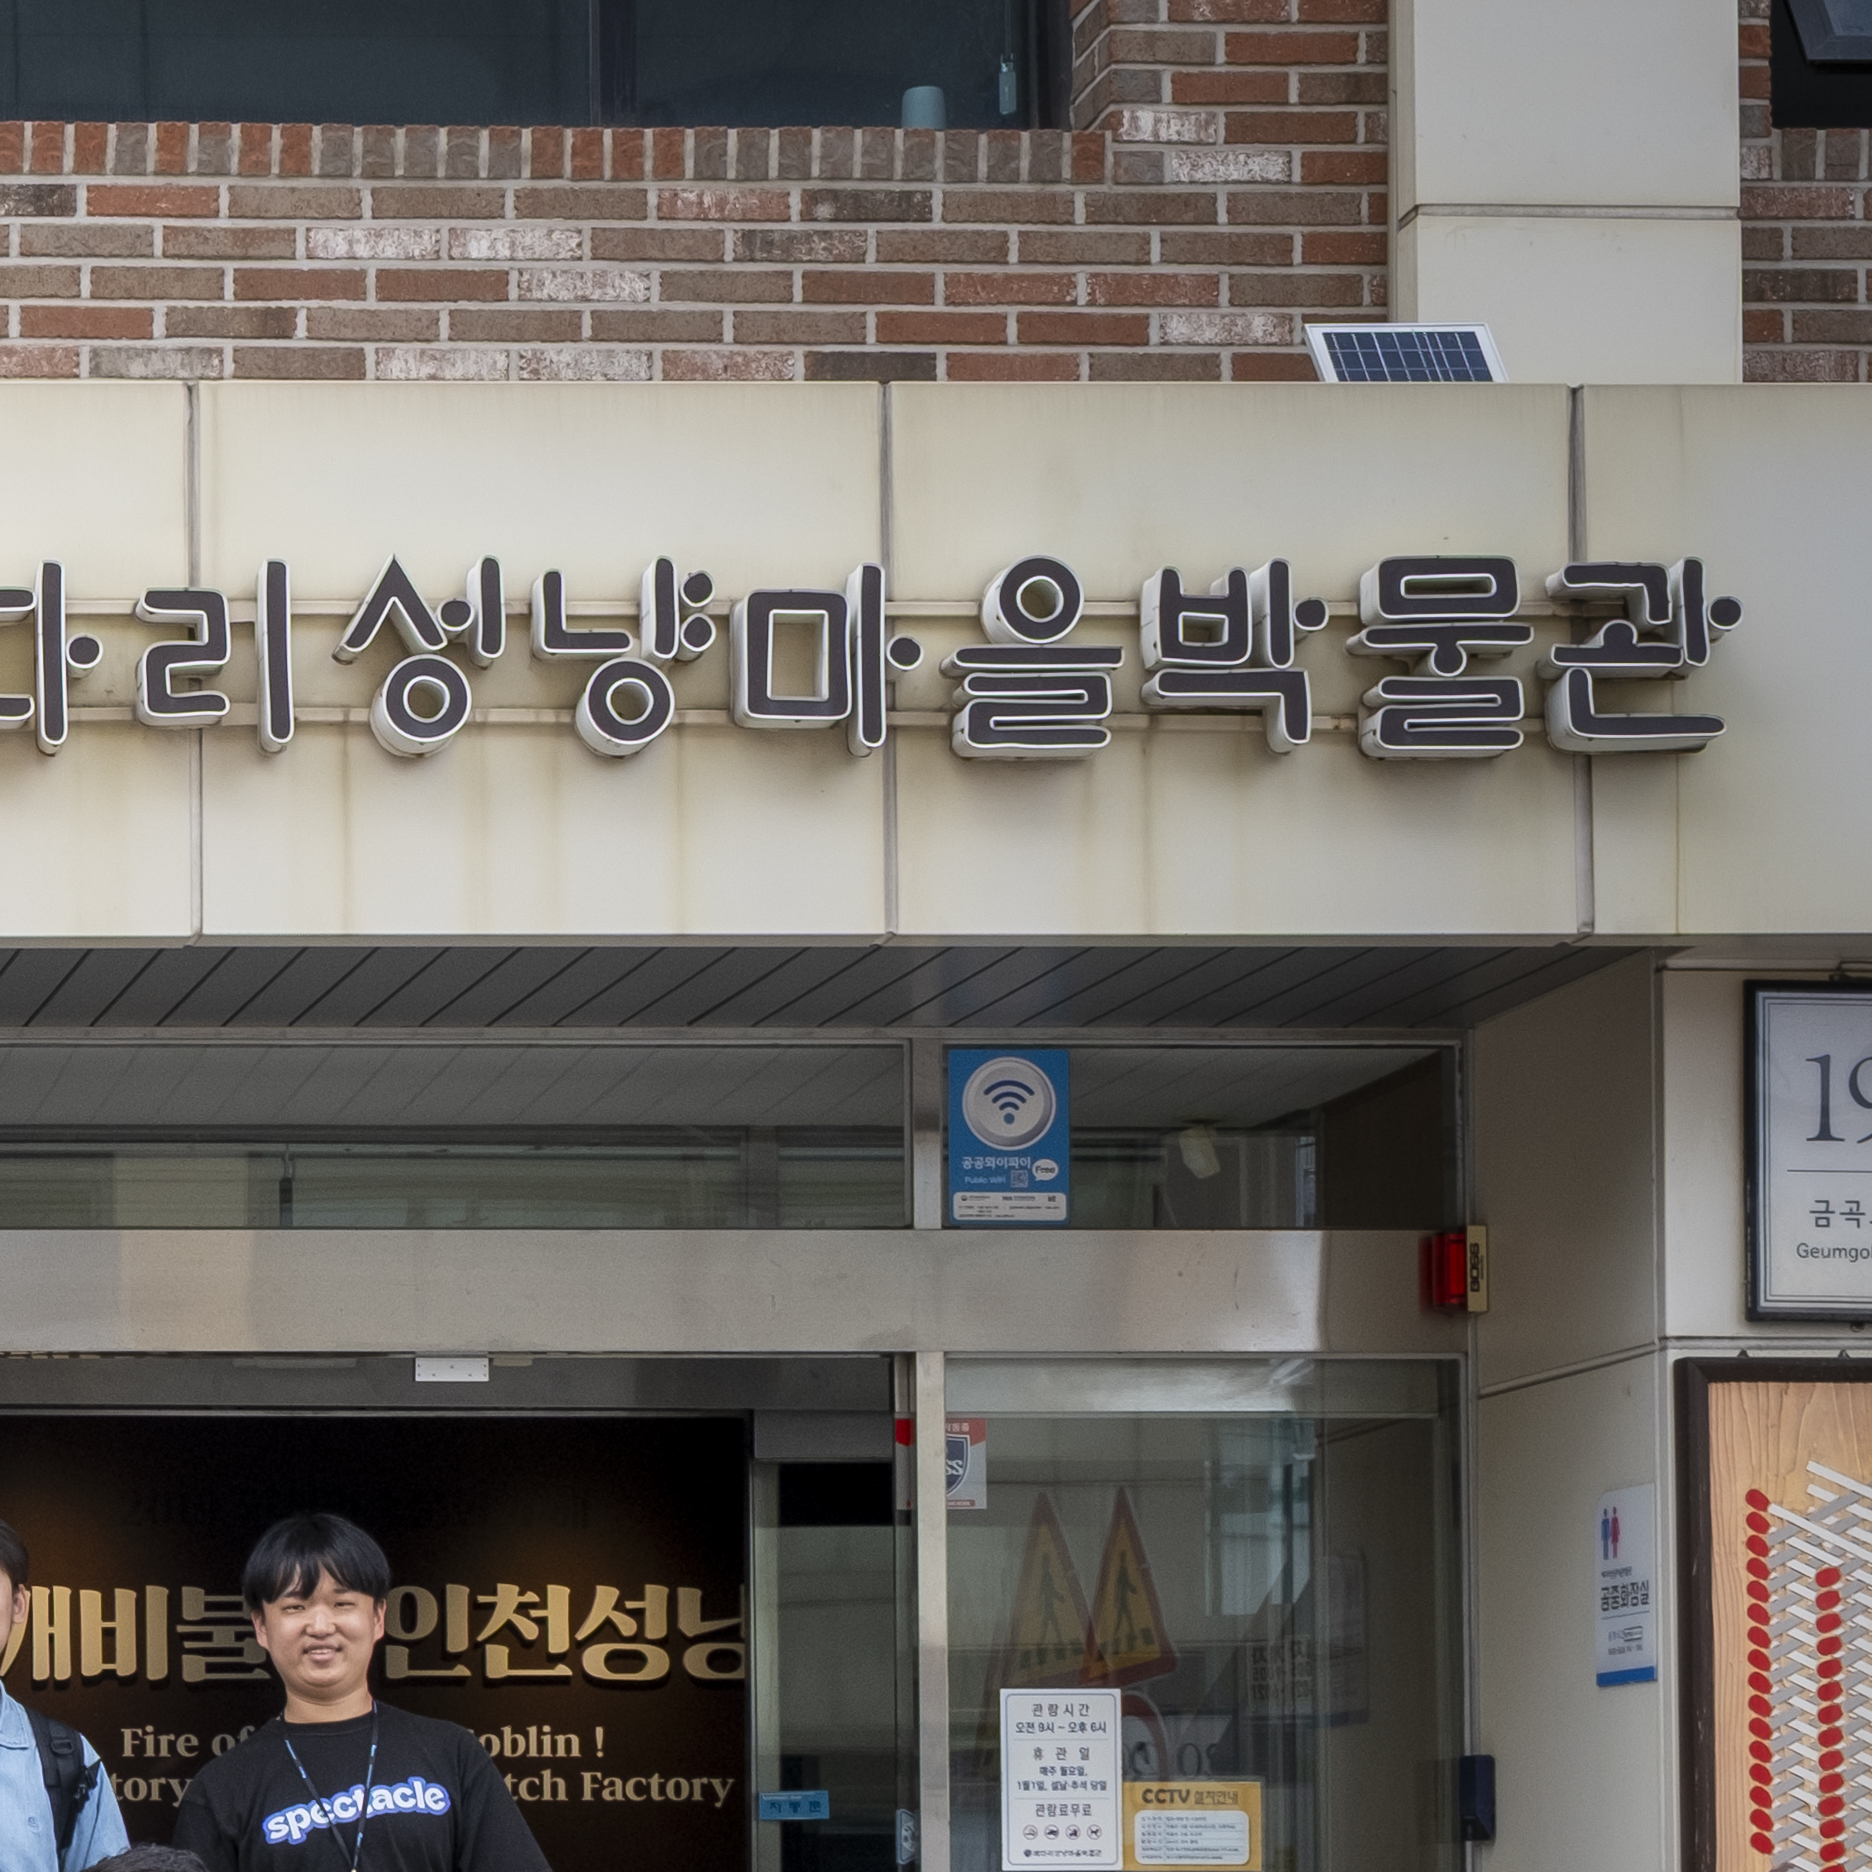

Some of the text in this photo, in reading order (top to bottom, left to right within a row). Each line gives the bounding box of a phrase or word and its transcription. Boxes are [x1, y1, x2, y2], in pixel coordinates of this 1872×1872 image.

[962, 1156, 1031, 1170] 공공와이파이
[1809, 1199, 1872, 1229] 금곡
[1469, 1242, 1480, 1292] BOSS
[1796, 1242, 1872, 1263] Geumgo
[1601, 1579, 1650, 1612] 공중화장실
[119, 1728, 199, 1758] Fire
[469, 1724, 582, 1758] oblin
[1015, 1722, 1036, 1733] 오전
[1038, 1722, 1055, 1733] 9시
[1068, 1722, 1088, 1733] 오후
[1090, 1721, 1107, 1733] 6시
[113, 1774, 195, 1807] tory
[580, 1772, 735, 1807] Factory
[1141, 1788, 1191, 1804] CCTV
[264, 1779, 449, 1843] spectacle
[1035, 1803, 1093, 1818] 관람료무료
